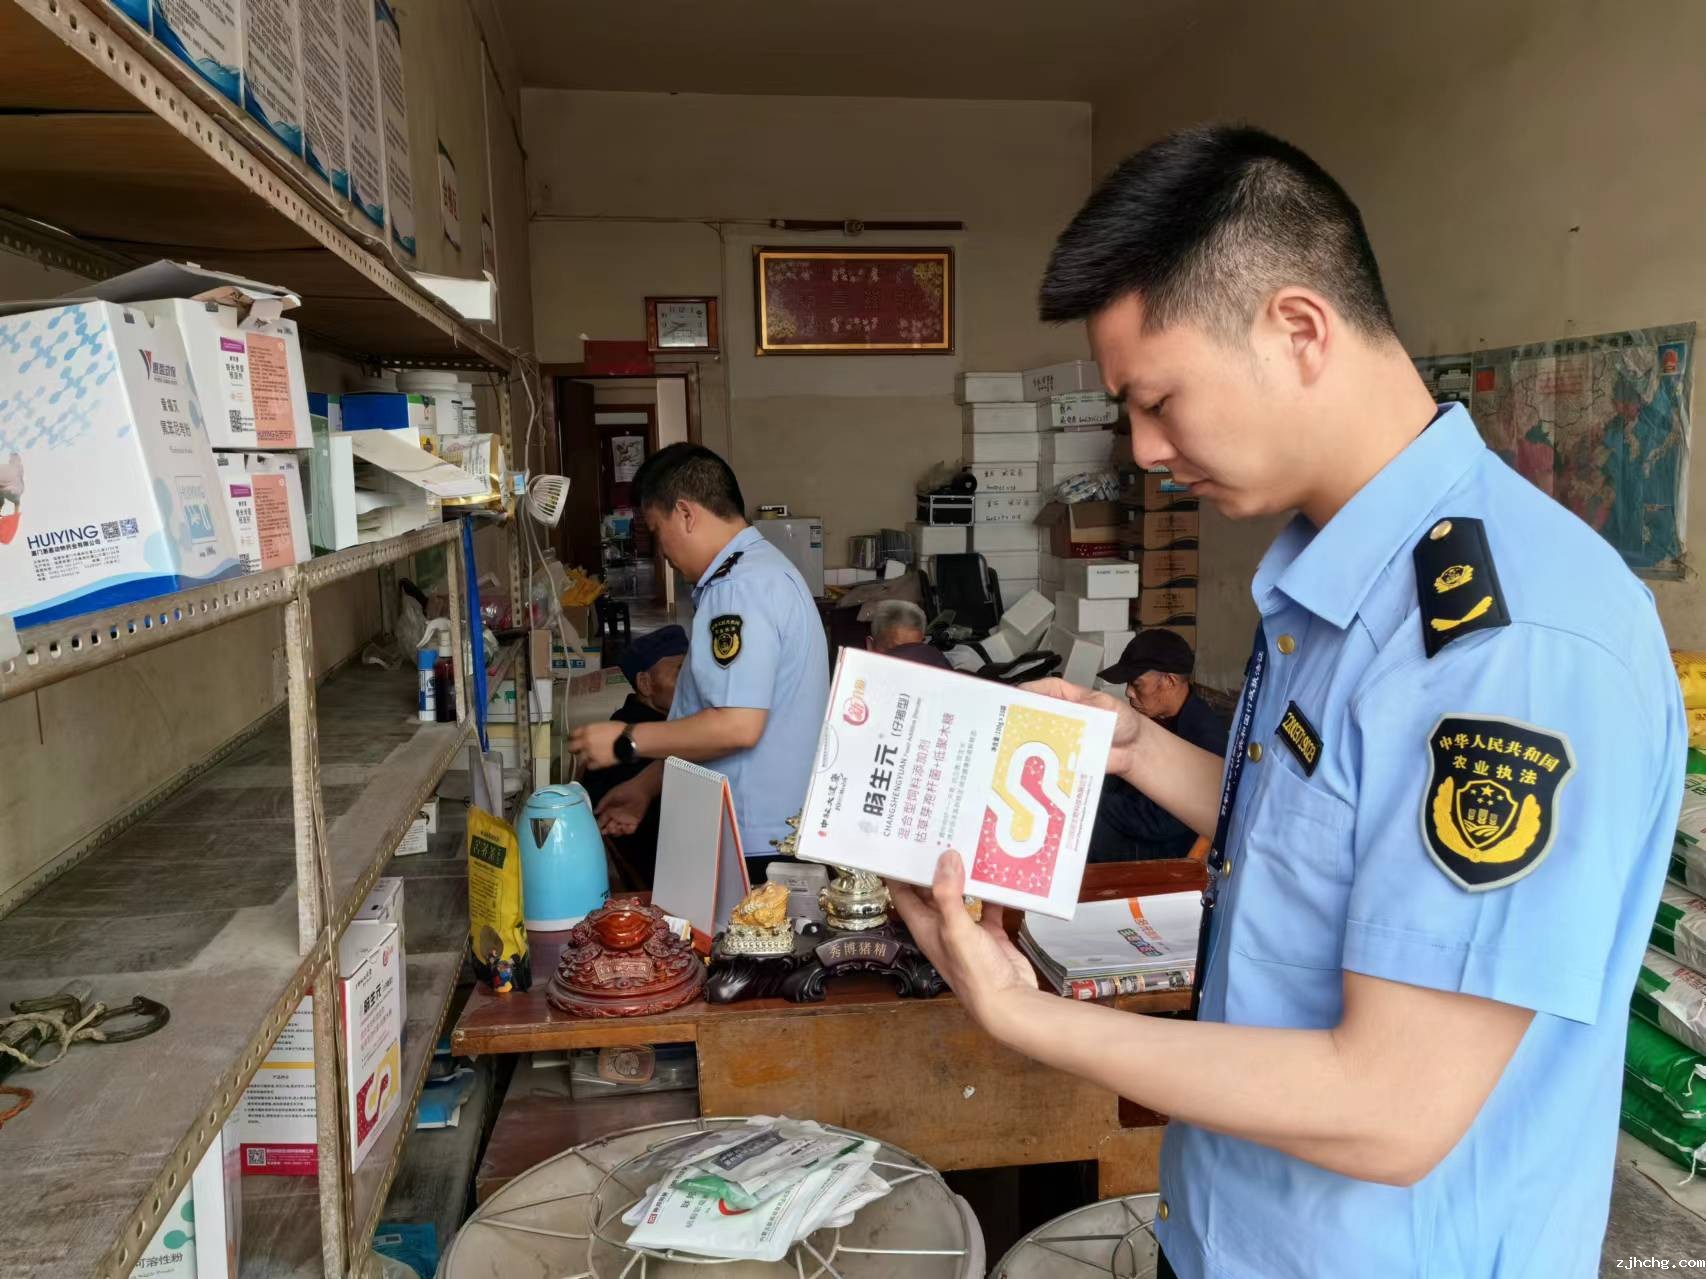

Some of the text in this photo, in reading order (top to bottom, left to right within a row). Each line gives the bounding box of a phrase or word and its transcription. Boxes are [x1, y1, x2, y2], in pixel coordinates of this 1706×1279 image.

[27, 525, 98, 549] HUIYING
[863, 743, 898, 816] 肠生元
[898, 739, 931, 840] 混合型饲料添加剂
[914, 712, 955, 843] 枯草芽孢杆菌+低聚木糖
[1440, 733, 1560, 773] 中华人民共和国
[1452, 755, 1538, 785] 农业执法
[883, 758, 907, 837] CHANGSHENGYUAN
